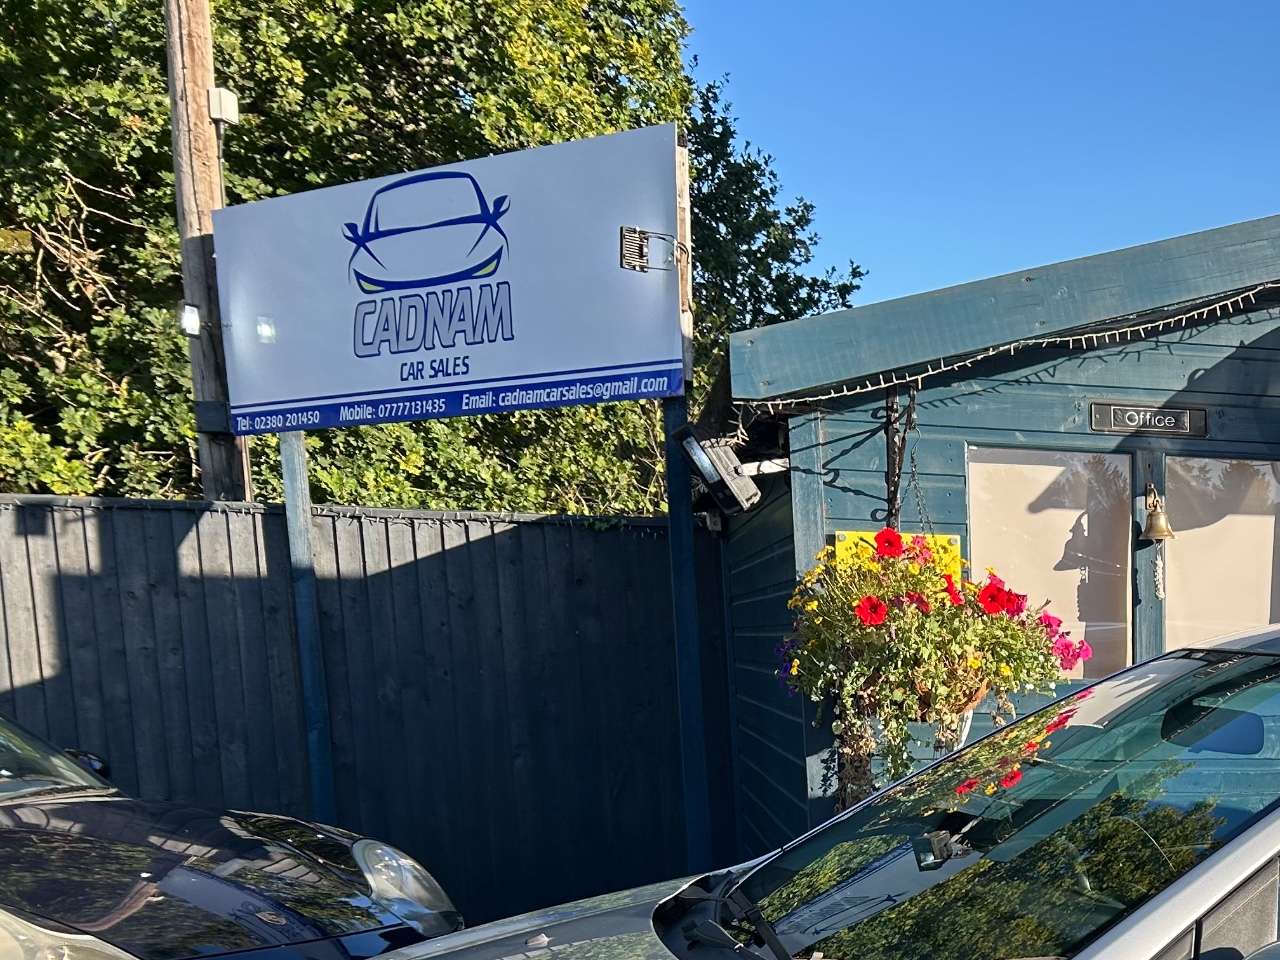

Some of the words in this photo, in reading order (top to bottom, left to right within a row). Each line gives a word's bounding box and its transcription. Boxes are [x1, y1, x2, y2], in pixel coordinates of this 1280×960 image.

[353, 280, 515, 358] CADNAM
[400, 360, 425, 382] CAR
[429, 355, 470, 379] SALES
[461, 391, 496, 410] Email:
[498, 376, 668, 407] cadnamcarsales@gmail.com
[236, 416, 252, 431] Tel:
[254, 414, 283, 430] 02380
[285, 410, 320, 427] 201450
[339, 404, 376, 422] Mobile:
[378, 398, 446, 418] 07777131435
[1125, 411, 1176, 427] Office
